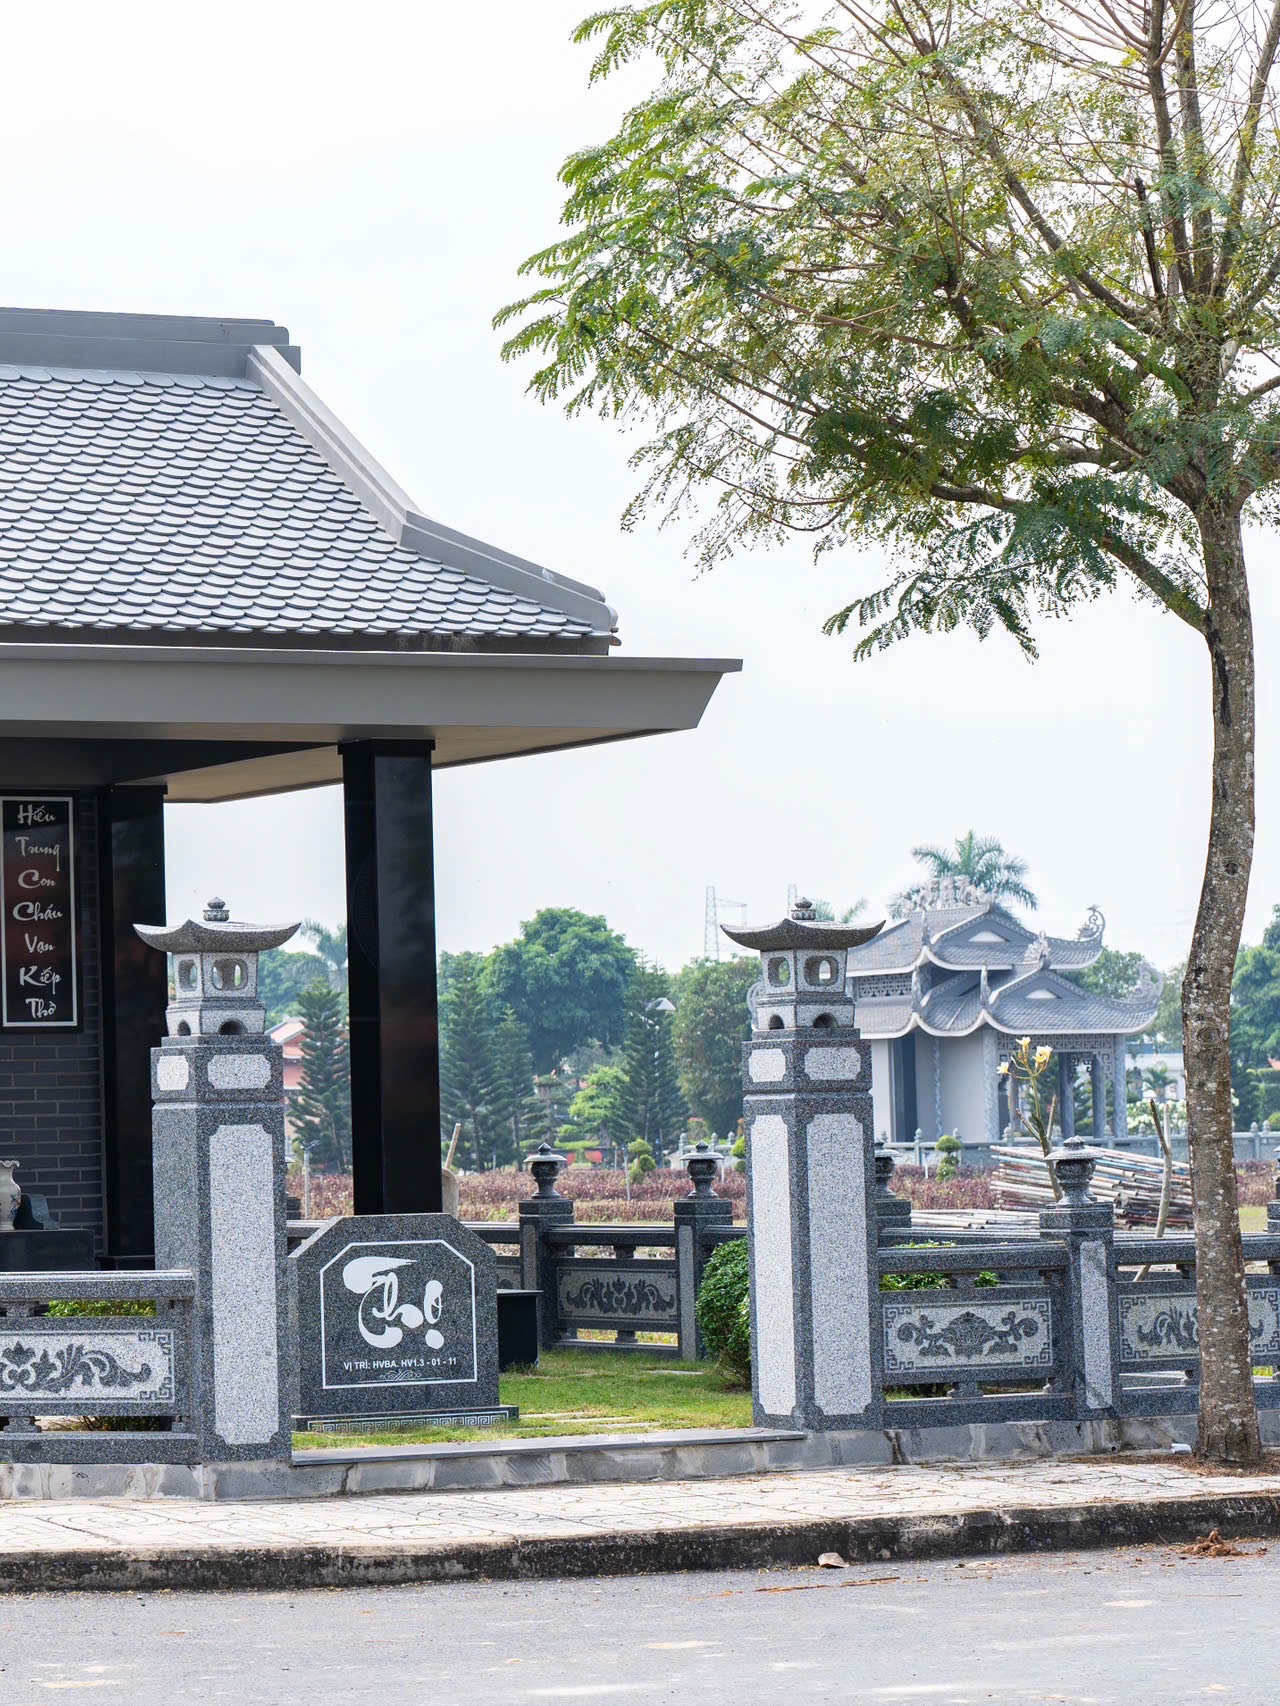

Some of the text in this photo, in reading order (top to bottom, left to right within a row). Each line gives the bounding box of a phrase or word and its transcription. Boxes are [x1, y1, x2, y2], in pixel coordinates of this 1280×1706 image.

[18, 804, 55, 825] Hiếu
[15, 836, 60, 872] Trung
[17, 869, 56, 889] Con
[12, 901, 63, 921] Cháu
[24, 933, 55, 954] Vạn
[19, 965, 62, 995] Kiếp
[25, 998, 57, 1019] Thờ
[343, 1256, 444, 1349] Thọ
[343, 1362, 353, 1372] VỊ
[372, 1360, 399, 1369] HVBA.
[401, 1358, 424, 1367] HV1.3
[431, 1358, 441, 1366] 01
[448, 1357, 457, 1365] 11
